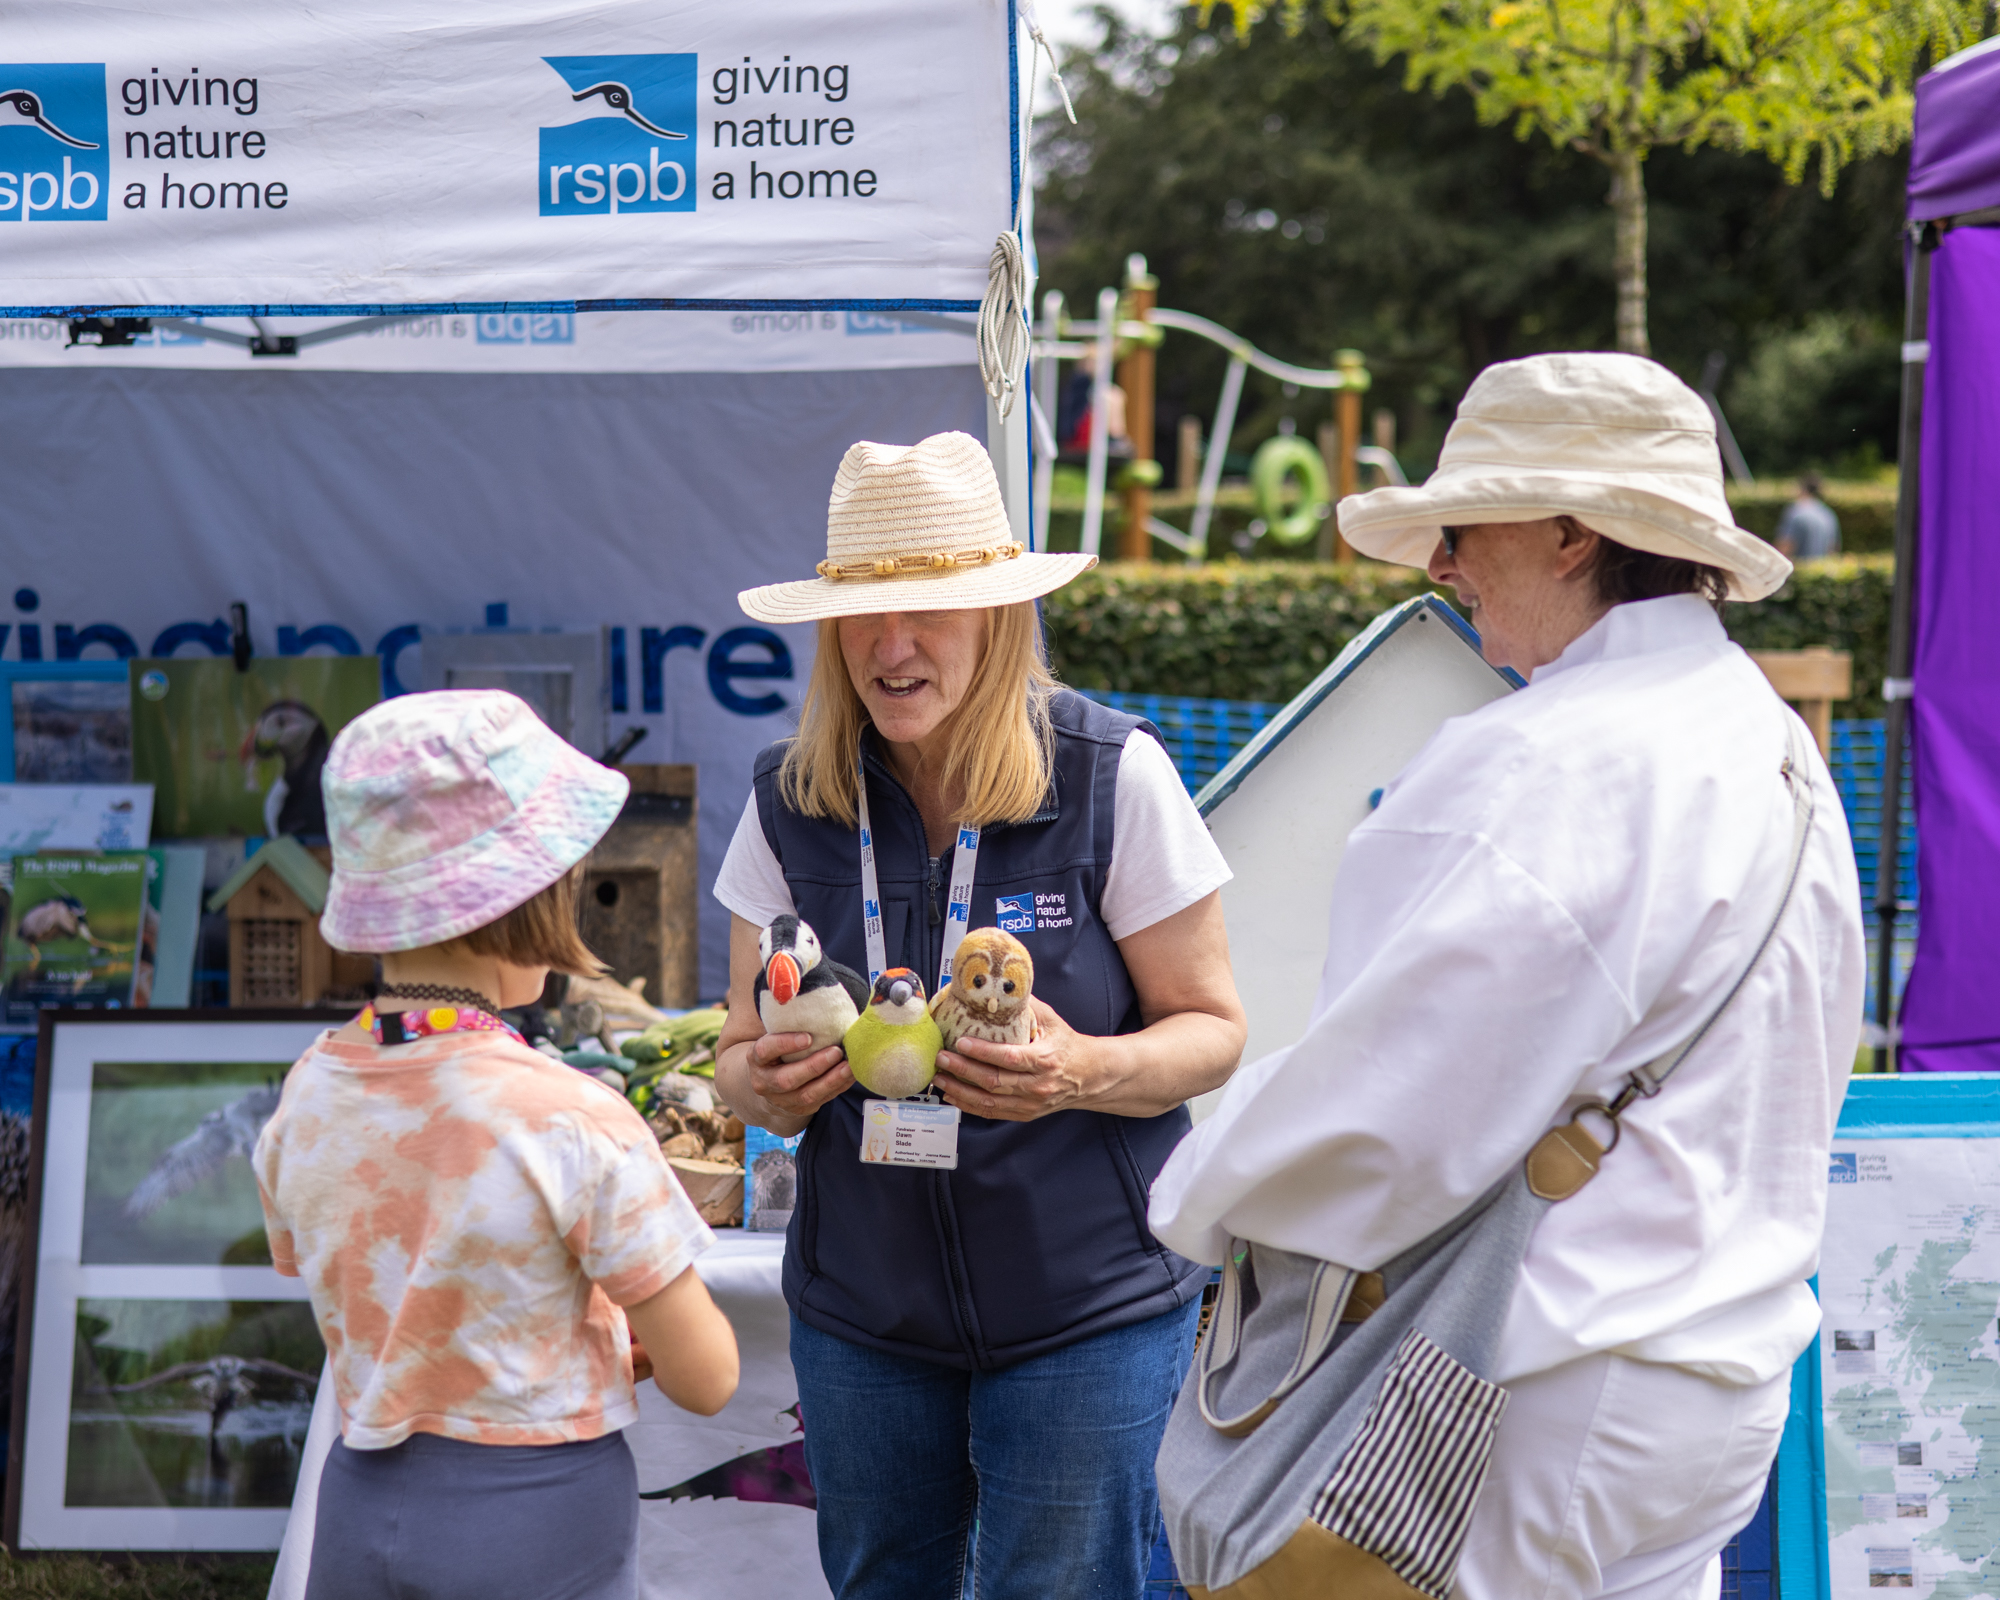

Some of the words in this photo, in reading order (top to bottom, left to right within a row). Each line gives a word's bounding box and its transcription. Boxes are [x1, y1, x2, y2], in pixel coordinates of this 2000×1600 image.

[712, 56, 849, 104] giving
[121, 68, 258, 116] giving
[714, 112, 855, 148] nature
[125, 121, 266, 160] nature
[549, 146, 687, 214] rspb
[712, 171, 735, 199] a
[750, 162, 877, 199] home
[123, 180, 147, 210] a
[161, 173, 289, 210] home
[969, 832, 978, 849] rspb
[1035, 893, 1065, 906] giving
[960, 904, 968, 921] rspb
[1036, 906, 1067, 916] nature
[1000, 914, 1032, 931] rspb
[1037, 919, 1044, 928] a
[1046, 917, 1073, 928] home
[942, 958, 950, 975] giving
[1859, 1154, 1886, 1163] giving
